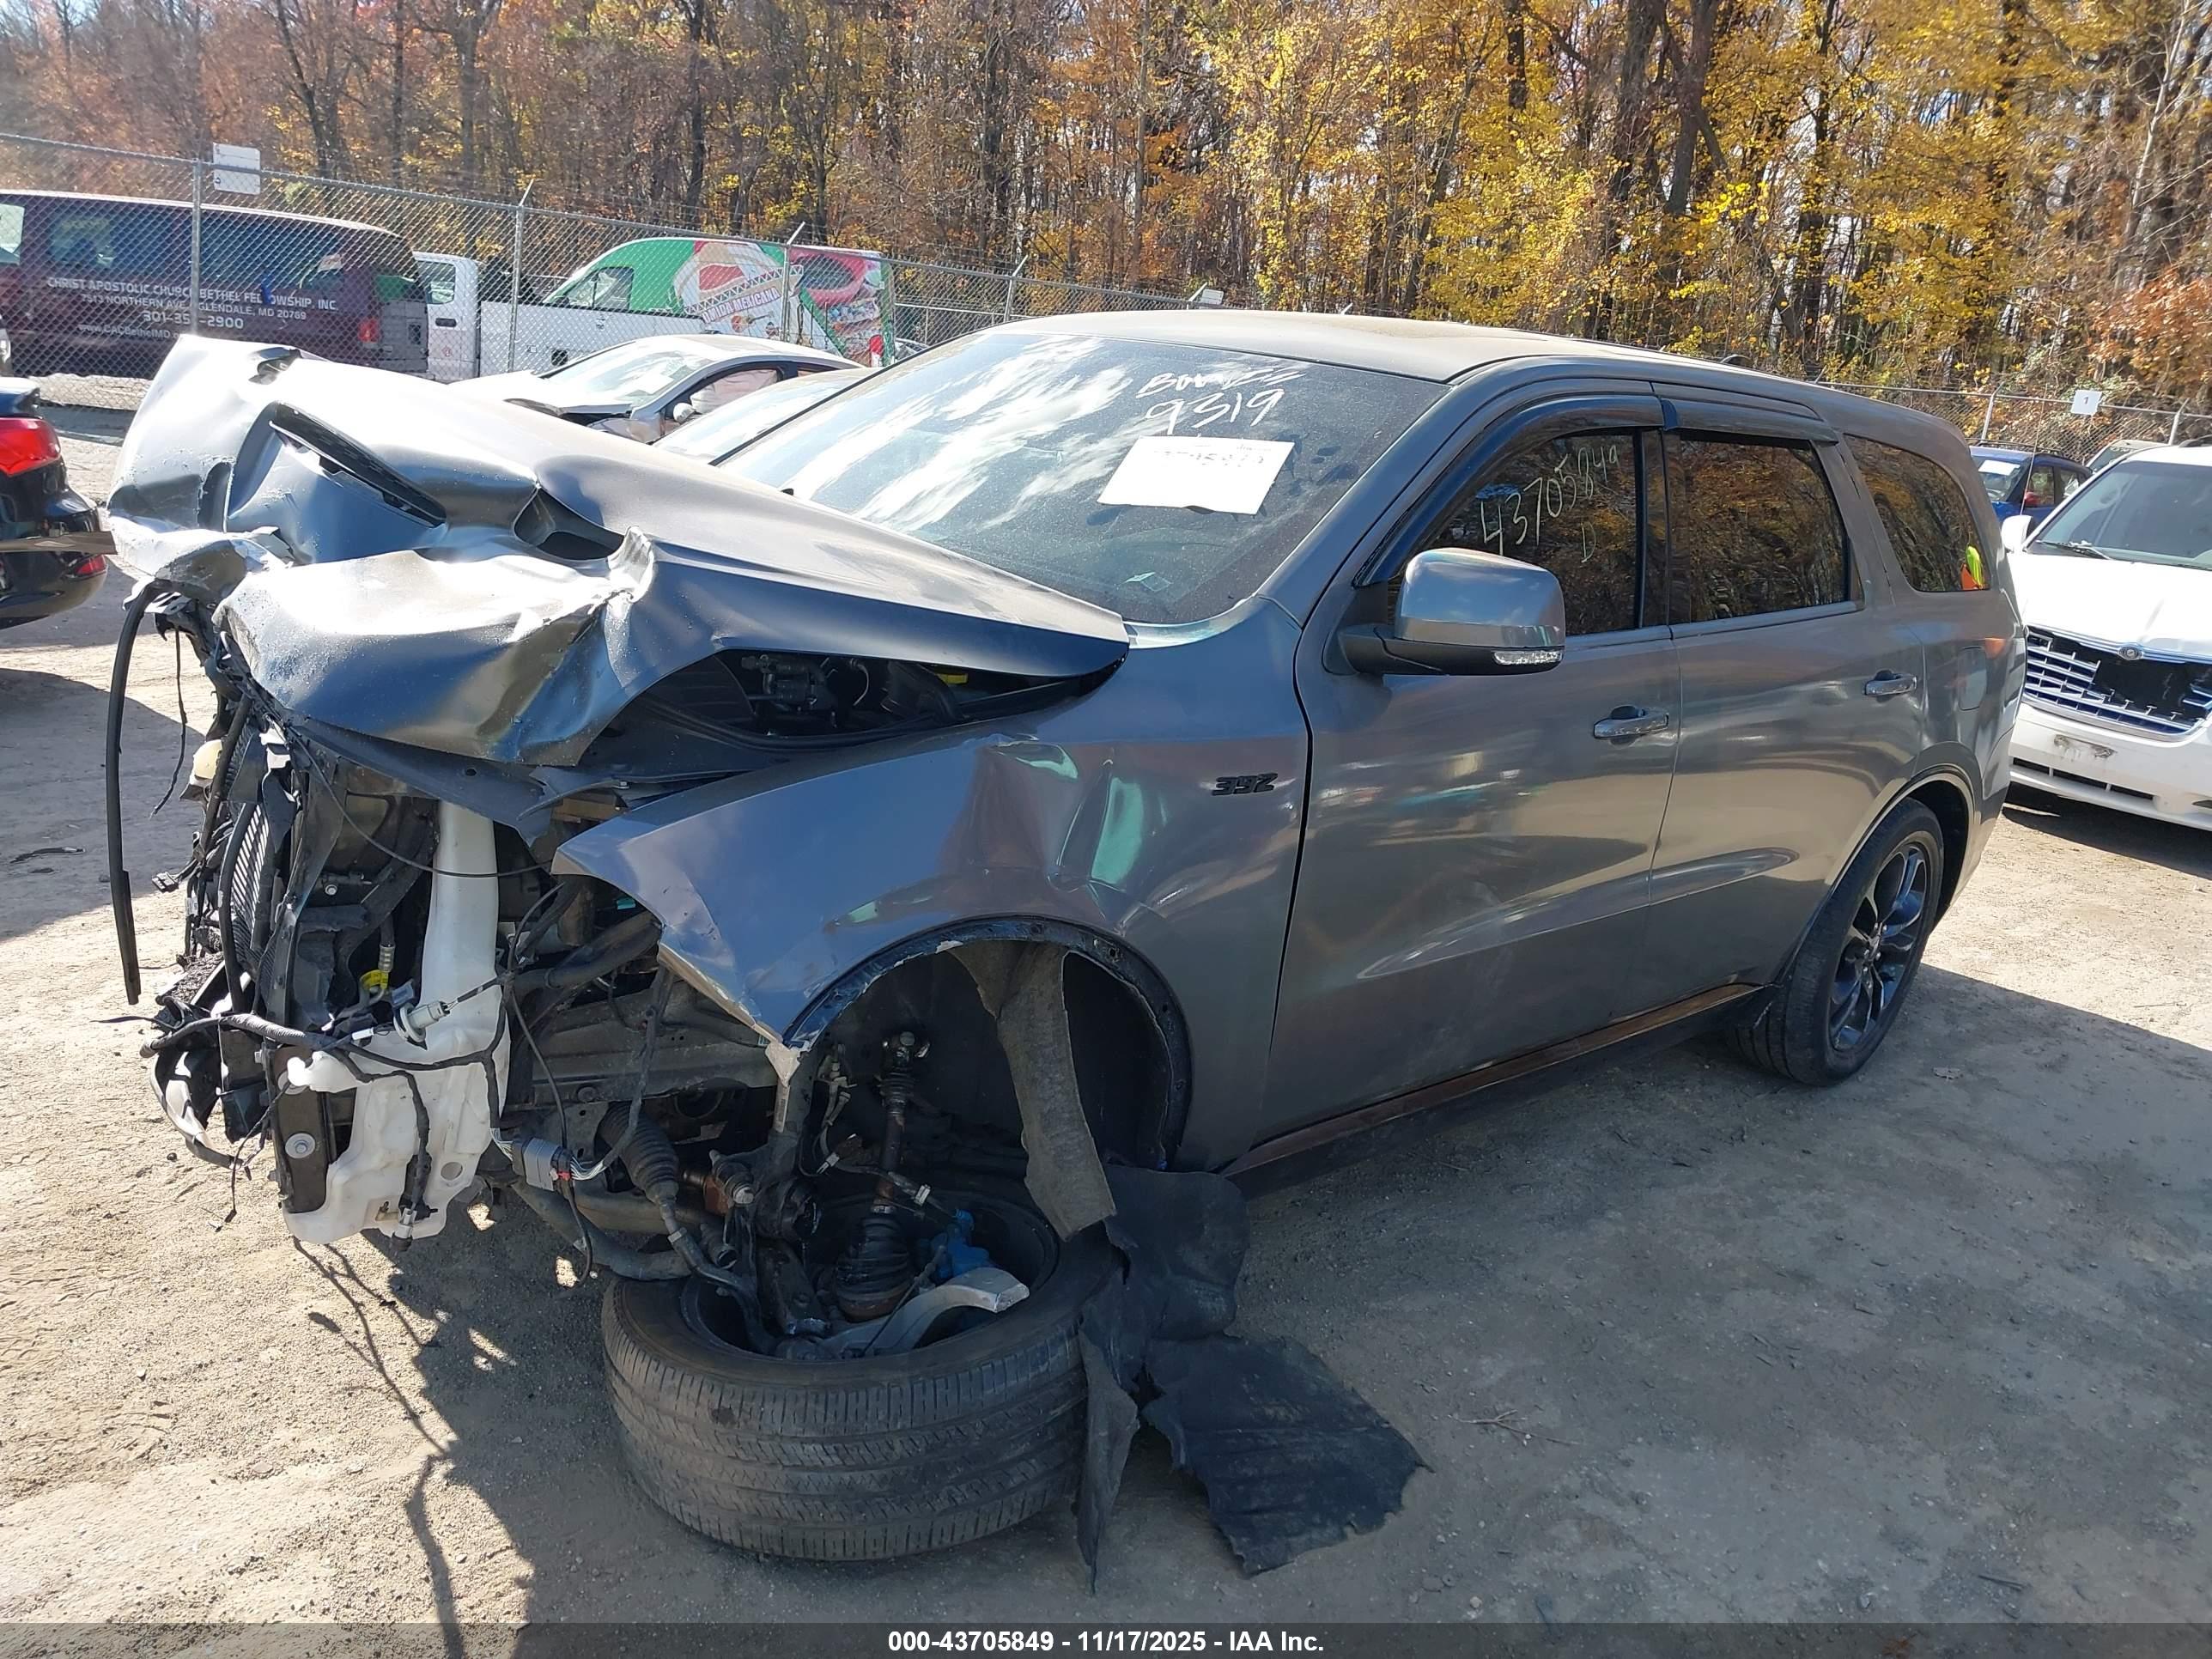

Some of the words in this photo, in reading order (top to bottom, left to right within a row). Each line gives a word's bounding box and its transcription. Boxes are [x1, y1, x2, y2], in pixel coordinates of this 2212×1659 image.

[47, 276, 87, 289] CHRIST
[88, 280, 151, 295] APOSTOLIC
[153, 284, 192, 299] CHURC
[198, 289, 240, 302] BETHEL
[143, 310, 244, 329] 301-35-2900
[258, 307, 275, 318] MD
[1146, 388, 1285, 435] 9319
[1476, 442, 1620, 557] 43705849
